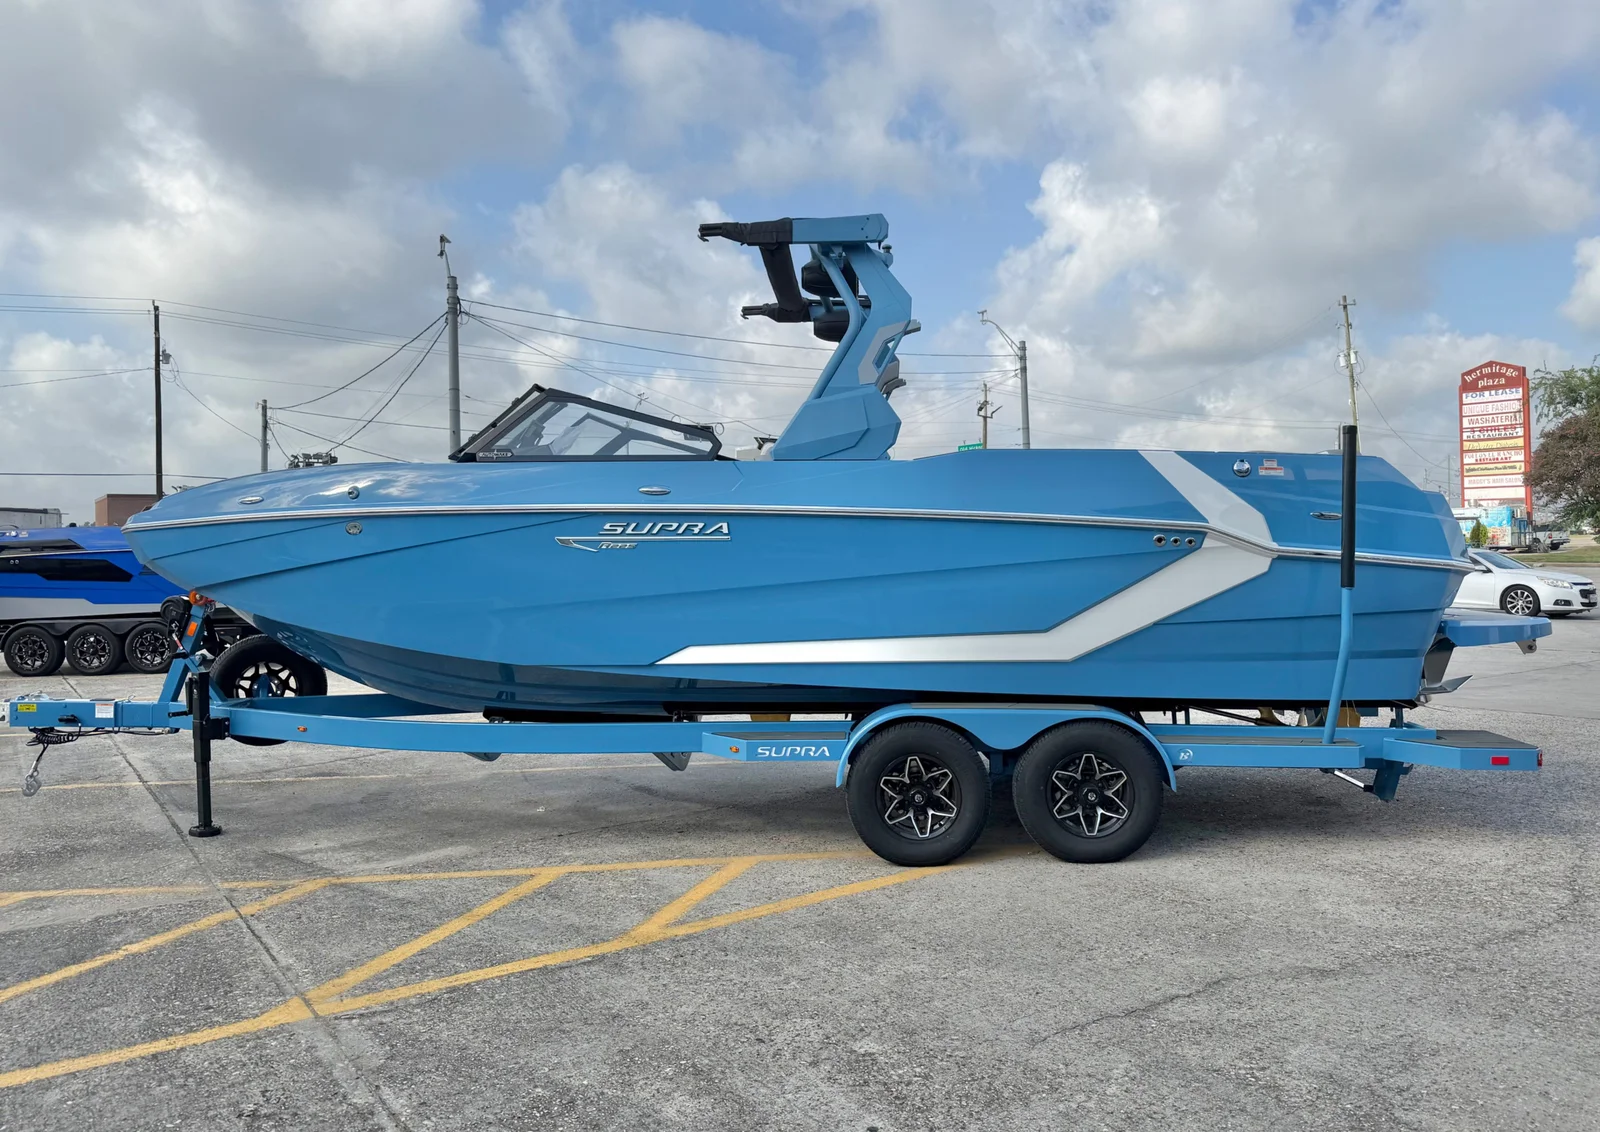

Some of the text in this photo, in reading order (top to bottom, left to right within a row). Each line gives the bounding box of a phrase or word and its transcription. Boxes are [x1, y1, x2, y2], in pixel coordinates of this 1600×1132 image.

[1464, 363, 1518, 382] hermitage
[1478, 377, 1505, 388] plaza
[1489, 388, 1520, 396] LEASE
[1463, 404, 1490, 414] UNIQUE
[1467, 414, 1518, 425] WASHATERIA
[1466, 431, 1519, 439] RESTAURANT
[599, 522, 730, 535] SUPRA
[757, 746, 831, 757] SUPRA
